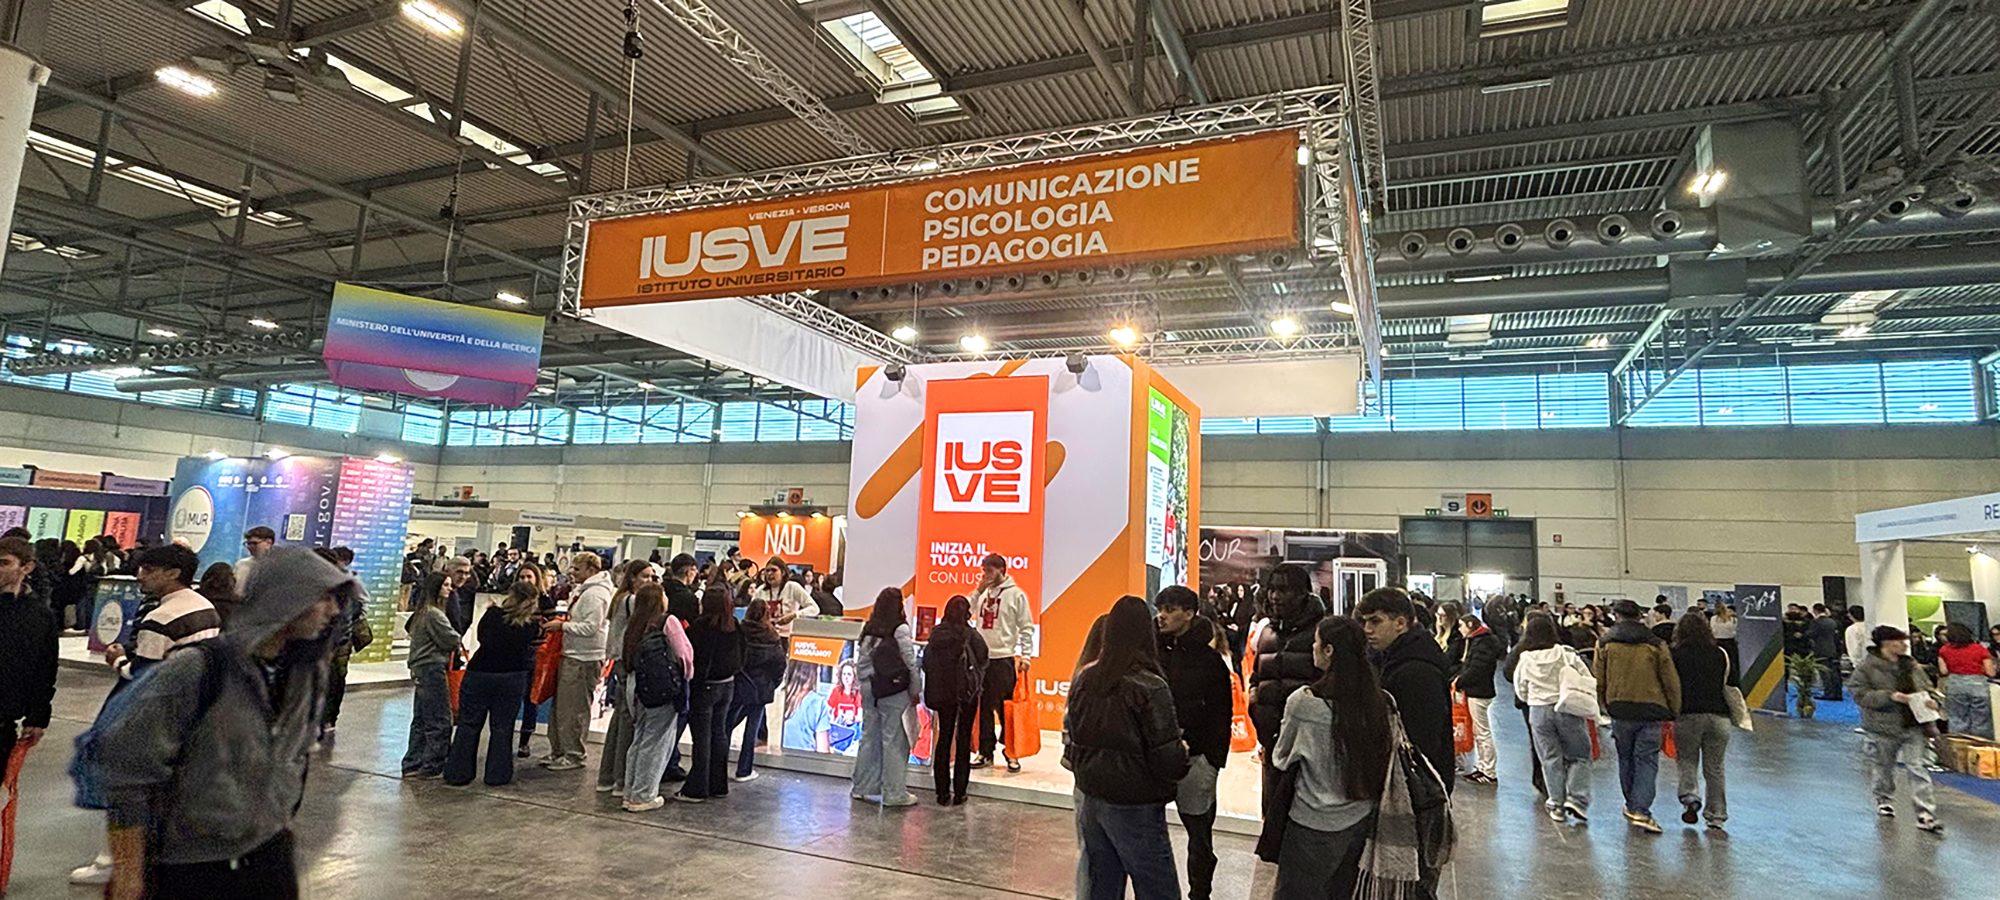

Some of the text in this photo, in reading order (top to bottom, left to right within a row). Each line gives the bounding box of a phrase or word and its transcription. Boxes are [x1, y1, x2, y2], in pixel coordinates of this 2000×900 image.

[924, 158, 1200, 214] COMUNICAZIONE
[749, 208, 794, 221] VENEZIA
[802, 201, 850, 215] VERONA
[923, 200, 1113, 242] PSICOLOGIA
[639, 214, 850, 280] IUSVE
[922, 230, 1109, 270] PEDAGOGIA
[637, 266, 846, 294] ISTITUTO UNIVERSITARIO
[336, 317, 537, 354] MINISTERO DELL'UNIVERSITÀ E DELLA RICERCA
[944, 440, 1023, 472] IUS
[944, 473, 1021, 503] VE
[186, 512, 209, 525] MUR
[1447, 501, 1460, 512] 9
[763, 523, 806, 556] NAD
[930, 542, 990, 555] INIZIA IL
[929, 571, 958, 583] CON
[930, 554, 1028, 570] TUO VIAIO!
